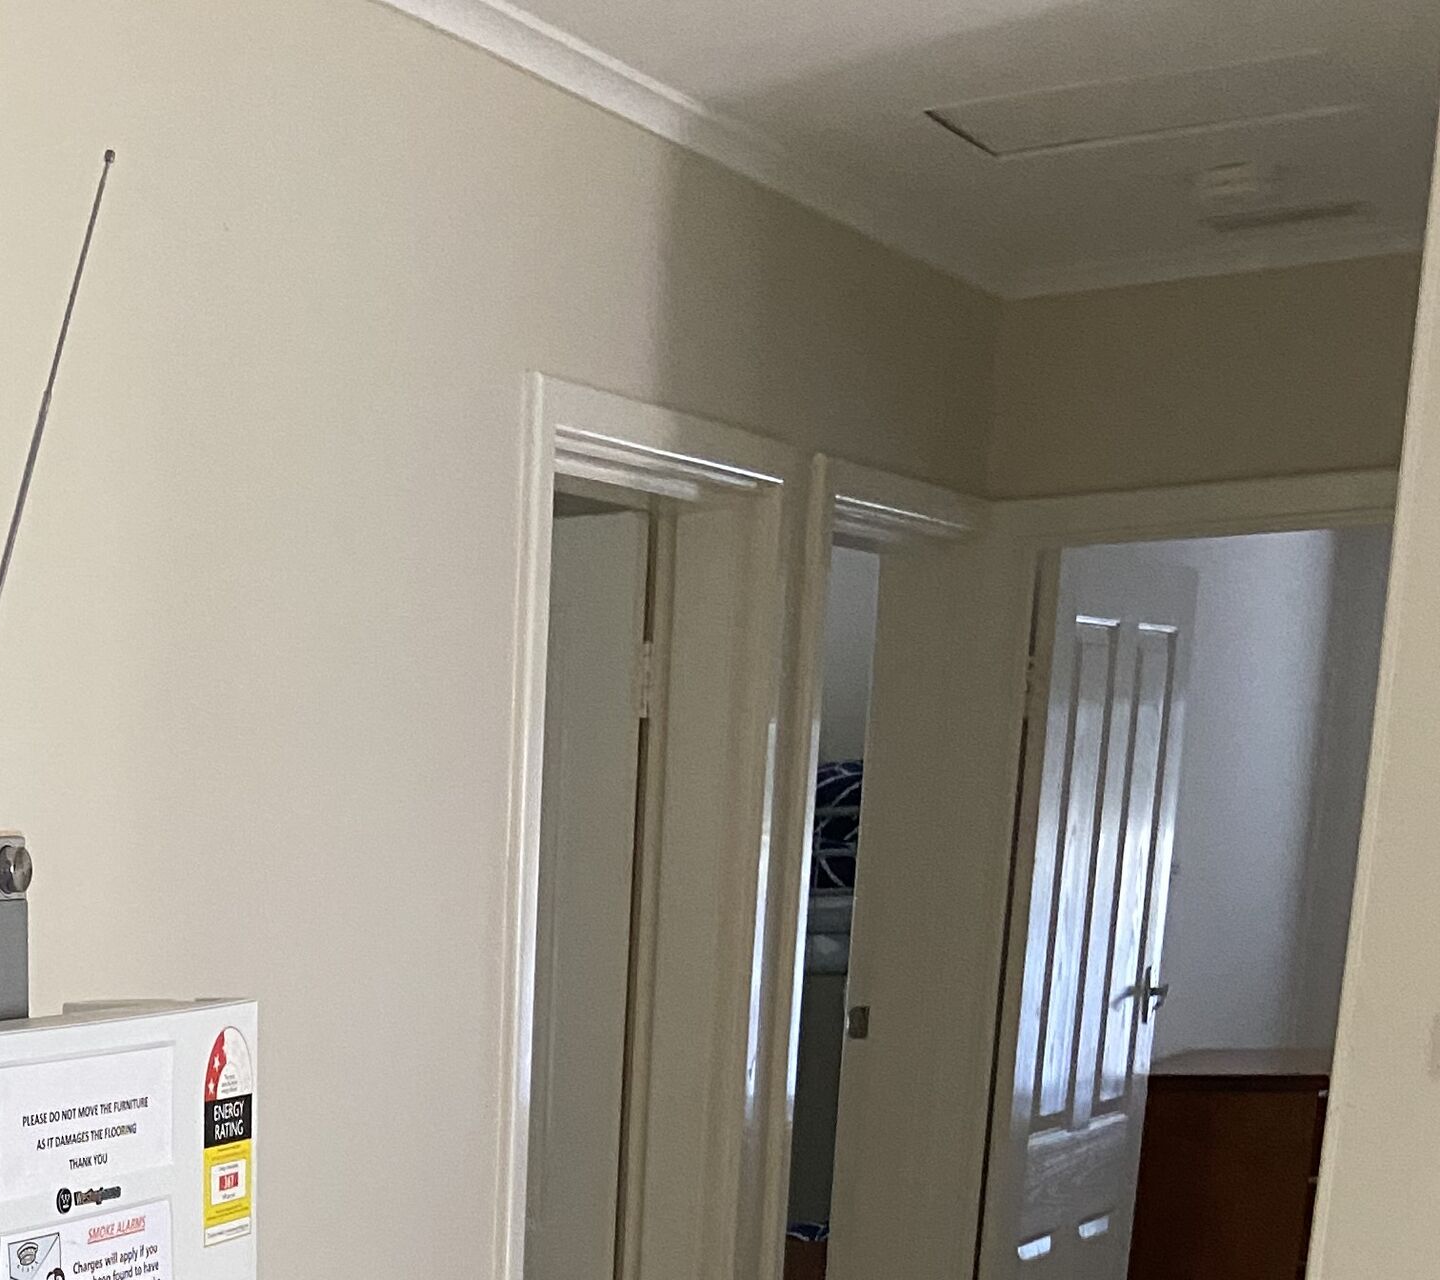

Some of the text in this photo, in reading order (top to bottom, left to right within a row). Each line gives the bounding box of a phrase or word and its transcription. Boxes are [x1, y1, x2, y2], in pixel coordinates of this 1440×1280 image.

[22, 1096, 149, 1127] PLEASE DO NOT MOVE THE FURNITURE
[213, 1100, 245, 1121] ENERGY
[36, 1123, 137, 1150] AS IT DAMAGES THE FLOORING
[214, 1121, 245, 1140] RATING
[69, 1153, 108, 1170] THANK YOU
[88, 1216, 146, 1241] SMOKE ALARMS
[72, 1244, 158, 1275] Charges will apply if you
[135, 1265, 142, 1276] to
[144, 1261, 159, 1274] have
